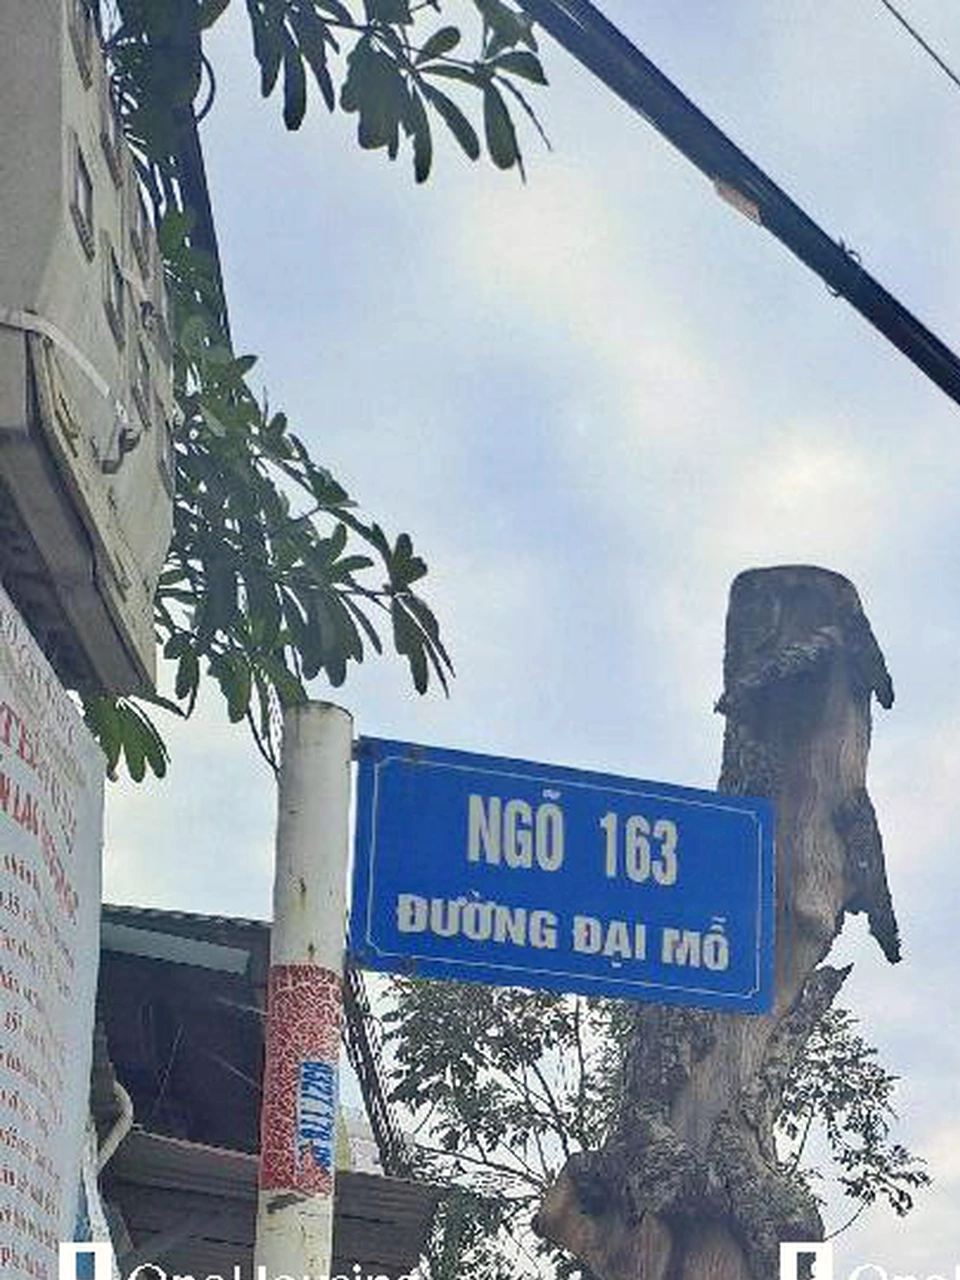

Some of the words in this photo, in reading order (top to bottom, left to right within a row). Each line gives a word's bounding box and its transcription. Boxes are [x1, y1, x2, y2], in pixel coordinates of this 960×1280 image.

[467, 789, 565, 871] NGÕ
[600, 812, 678, 886] 163
[396, 889, 558, 949] ĐƯỜNG
[572, 915, 647, 967] ĐẠI
[662, 916, 730, 971] MỖ
